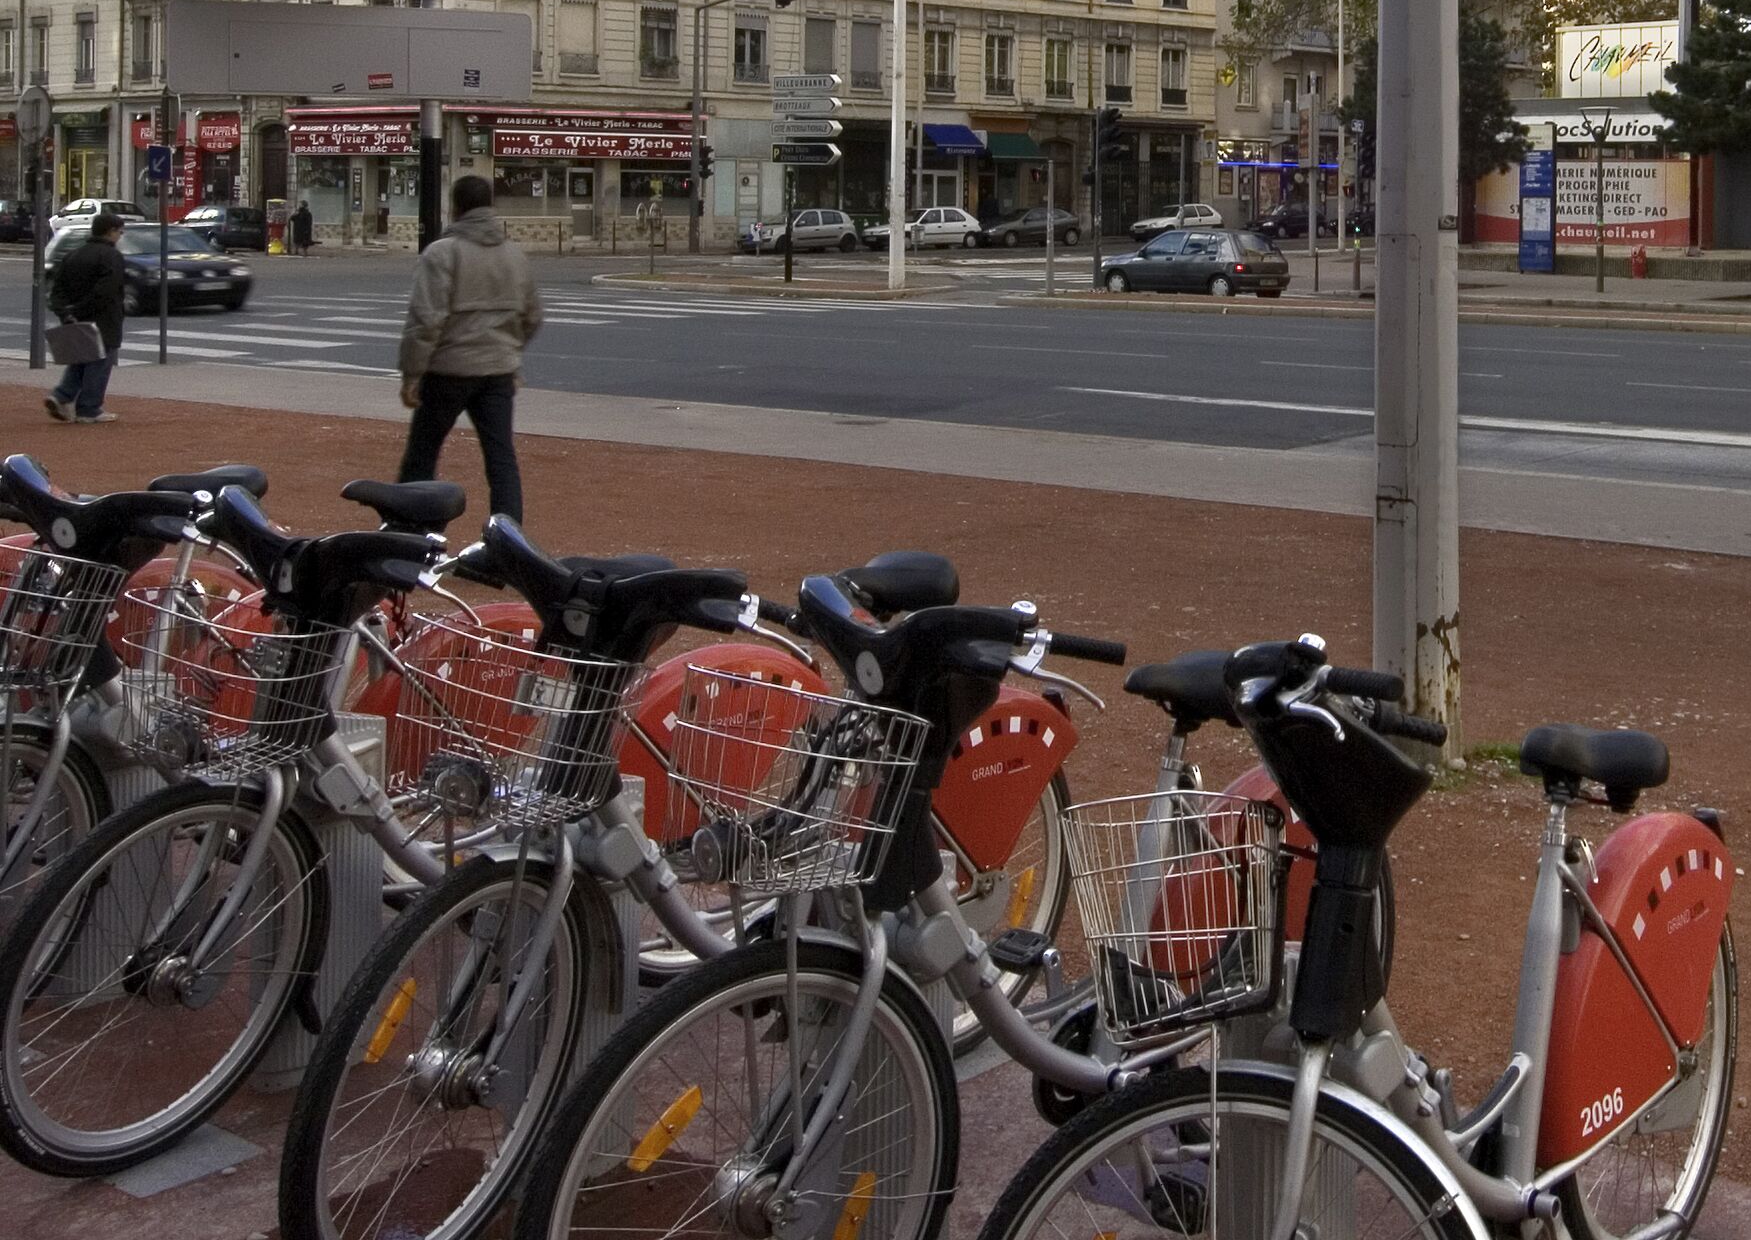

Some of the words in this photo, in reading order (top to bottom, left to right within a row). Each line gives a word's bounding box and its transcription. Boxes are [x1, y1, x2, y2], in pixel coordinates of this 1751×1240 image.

[496, 117, 548, 125] BRASSERIE
[554, 117, 569, 127] Le
[571, 119, 601, 128] Vivier
[309, 133, 324, 145] Le
[332, 133, 367, 145] Vivier
[374, 133, 407, 145] Merle
[529, 134, 553, 147] Le
[565, 136, 618, 148] Vivier
[629, 137, 674, 149] Merle
[502, 147, 579, 156] BRASSERIE
[607, 149, 649, 157] TABAC
[1604, 193, 1642, 203] DIRECT
[1614, 206, 1635, 216] GED
[1645, 207, 1668, 217] PAO
[972, 762, 1003, 781] GRAND
[1580, 1087, 1624, 1137] 2096
